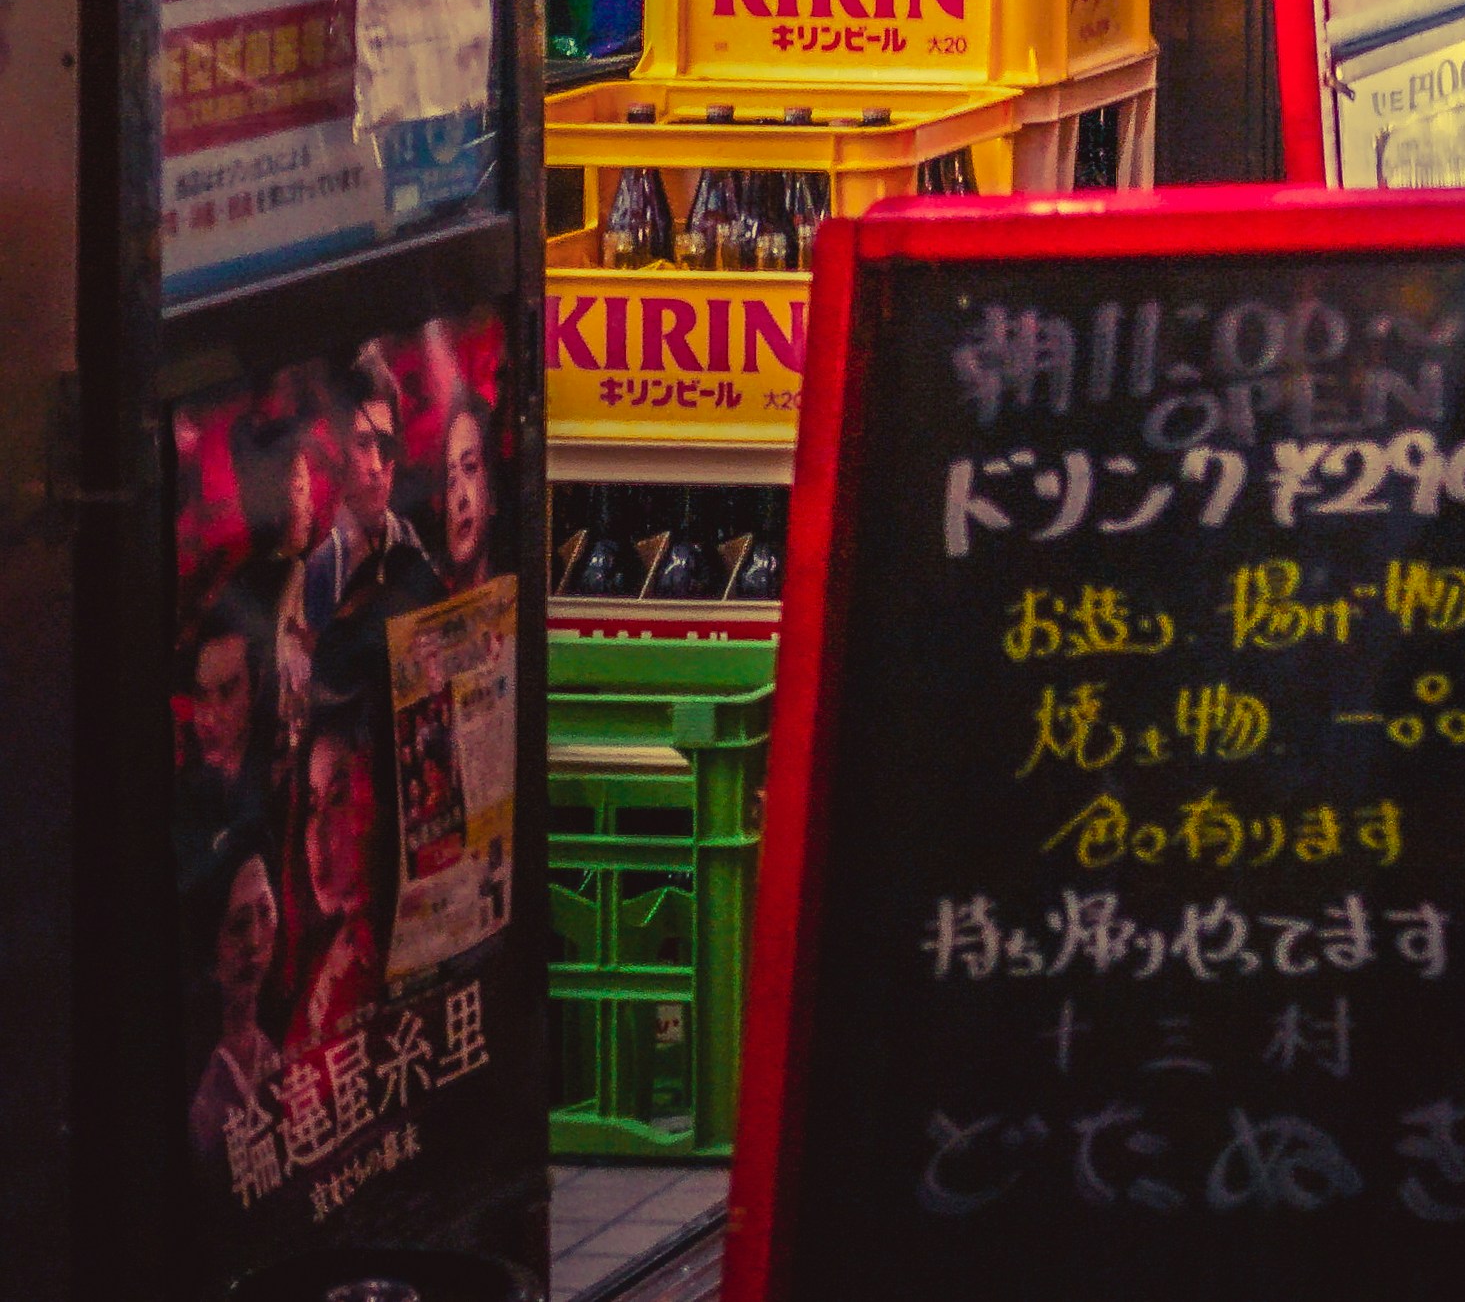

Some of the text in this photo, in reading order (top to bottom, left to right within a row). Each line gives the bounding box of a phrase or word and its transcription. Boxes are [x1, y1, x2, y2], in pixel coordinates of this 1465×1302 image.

[771, 24, 907, 53] キリンビール
[547, 295, 803, 374] KIRIN
[599, 378, 742, 410] キリンビール
